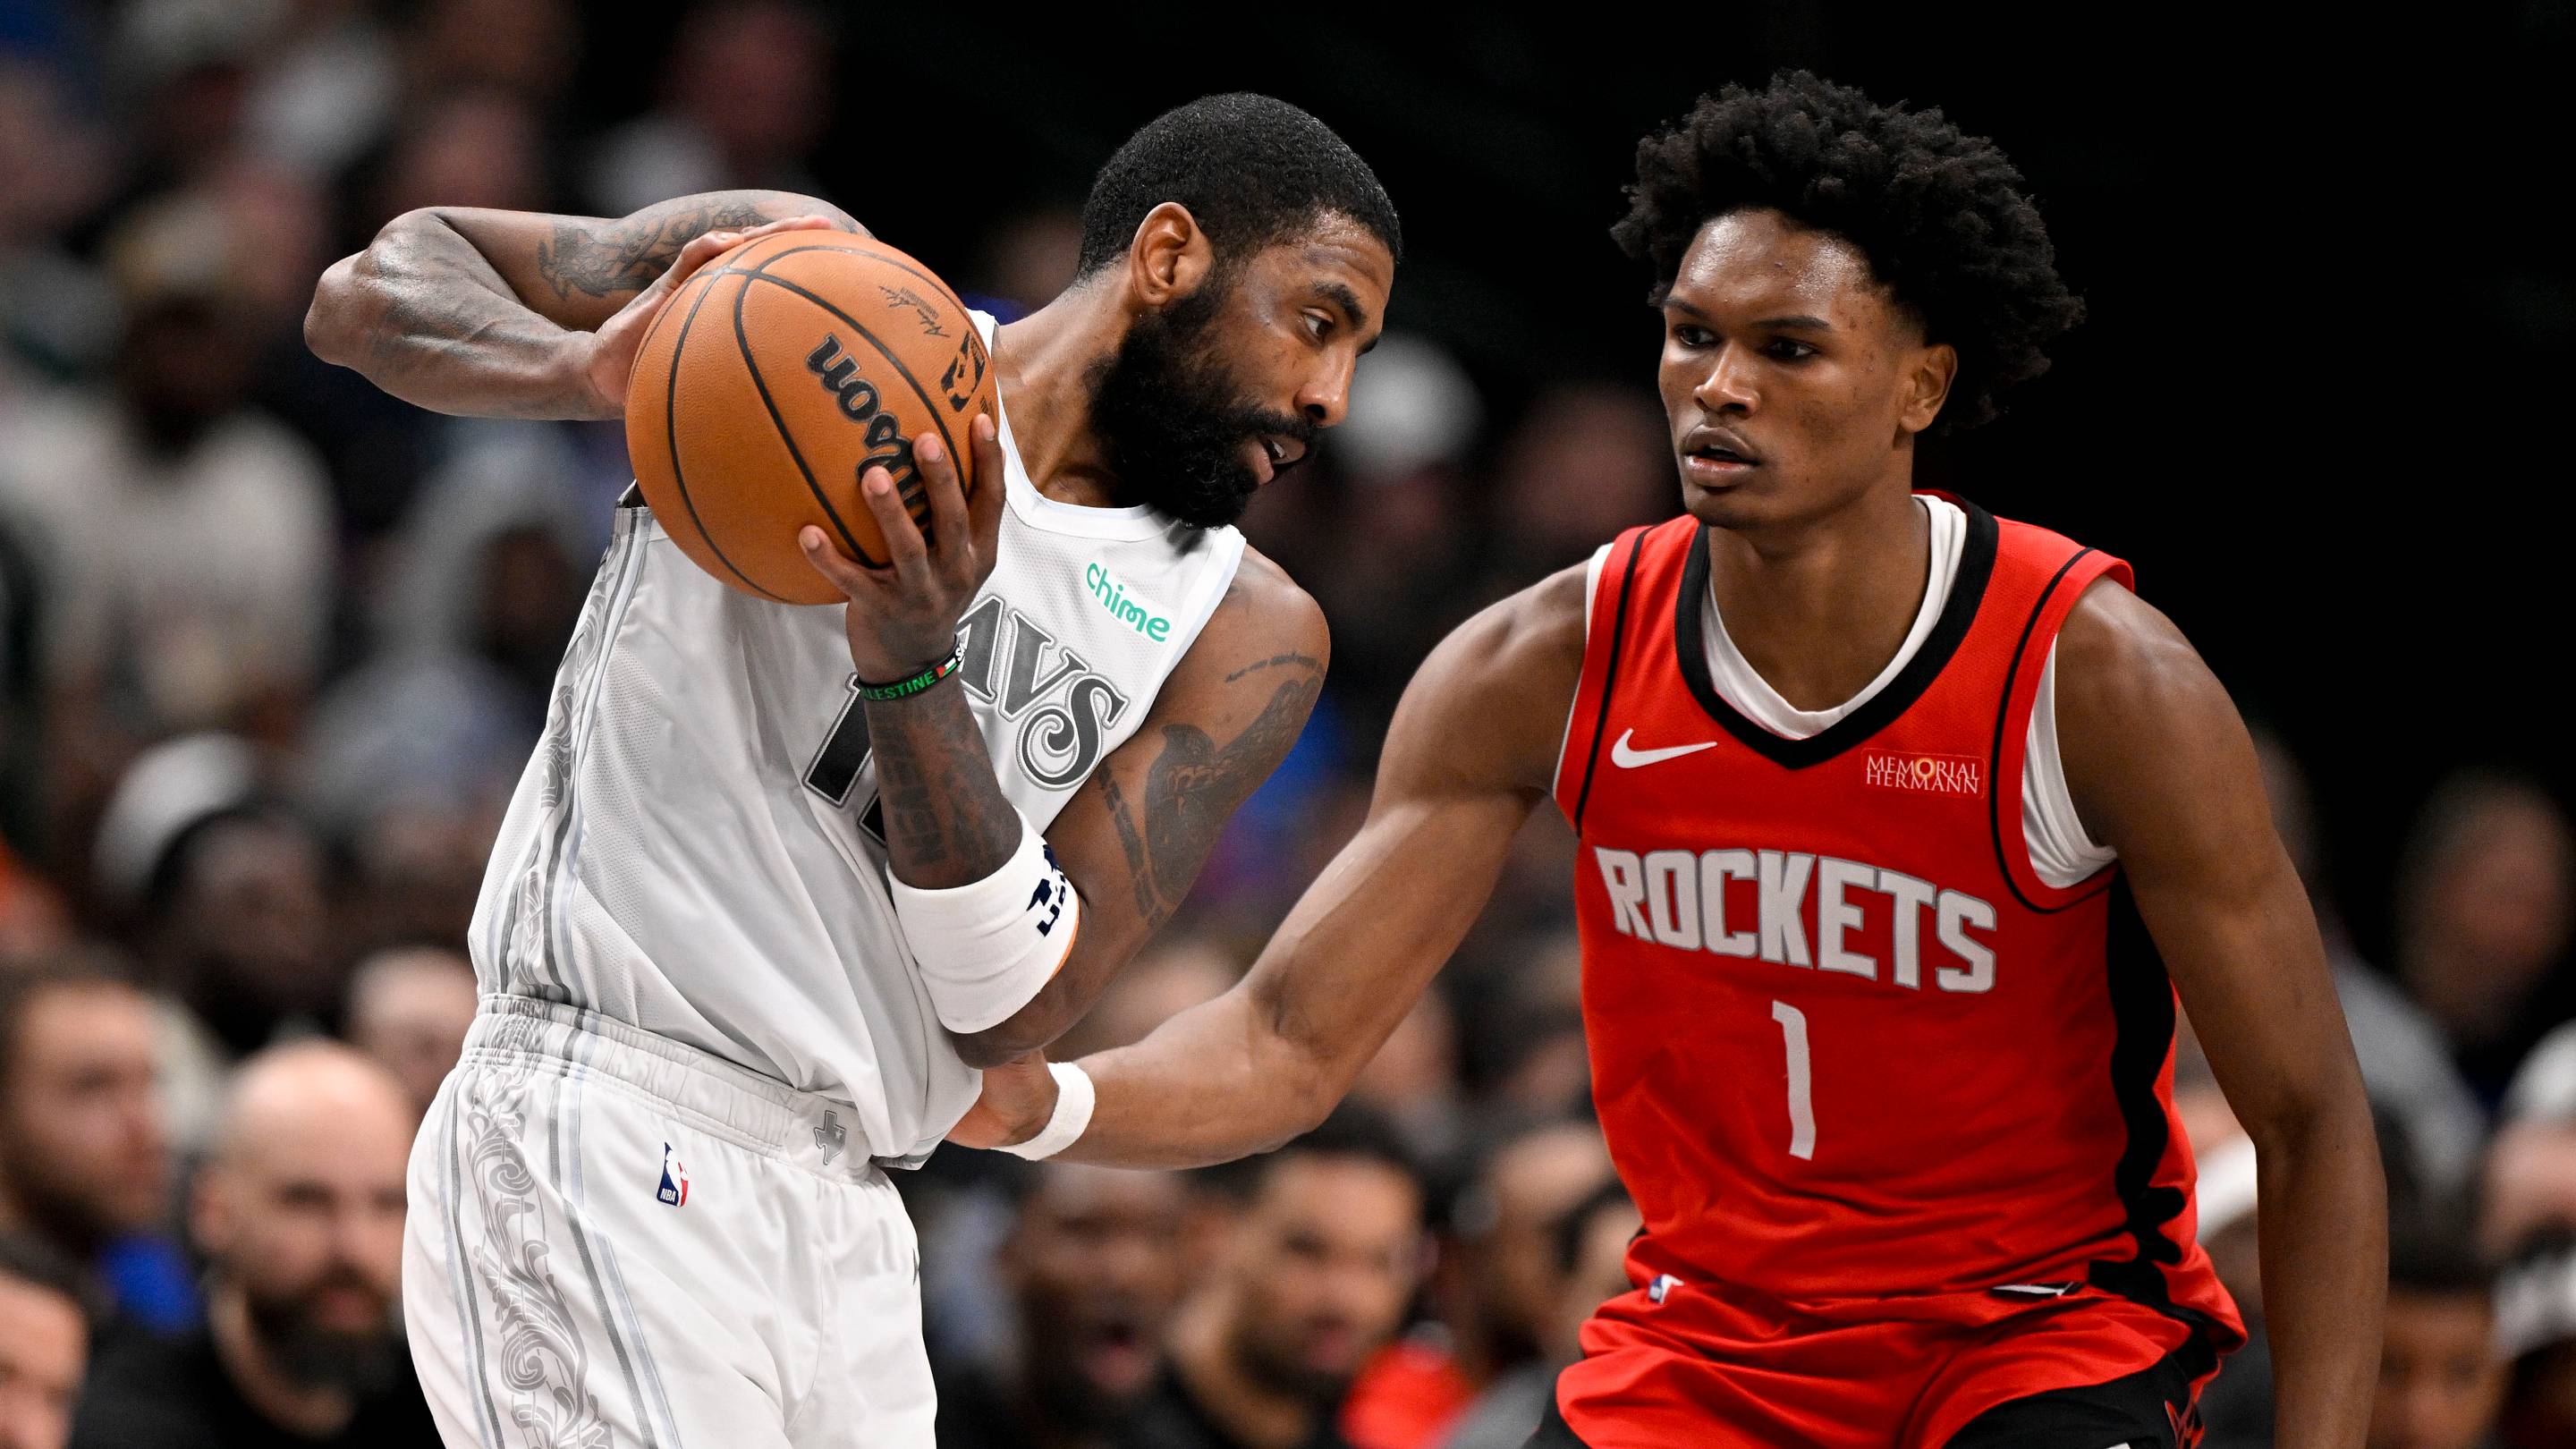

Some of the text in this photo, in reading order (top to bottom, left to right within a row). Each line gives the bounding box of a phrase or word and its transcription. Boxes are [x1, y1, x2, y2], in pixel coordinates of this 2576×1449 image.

[806, 332, 936, 549] lson
[1086, 562, 1171, 642] chime
[954, 593, 1131, 792] AVS
[1866, 755, 1979, 780] MEMORIAL
[1866, 768, 1979, 794] HERMANN
[1593, 845, 1997, 995] ROCKETS
[1771, 999, 1817, 1162] 1
[660, 1188, 676, 1203] NBA
